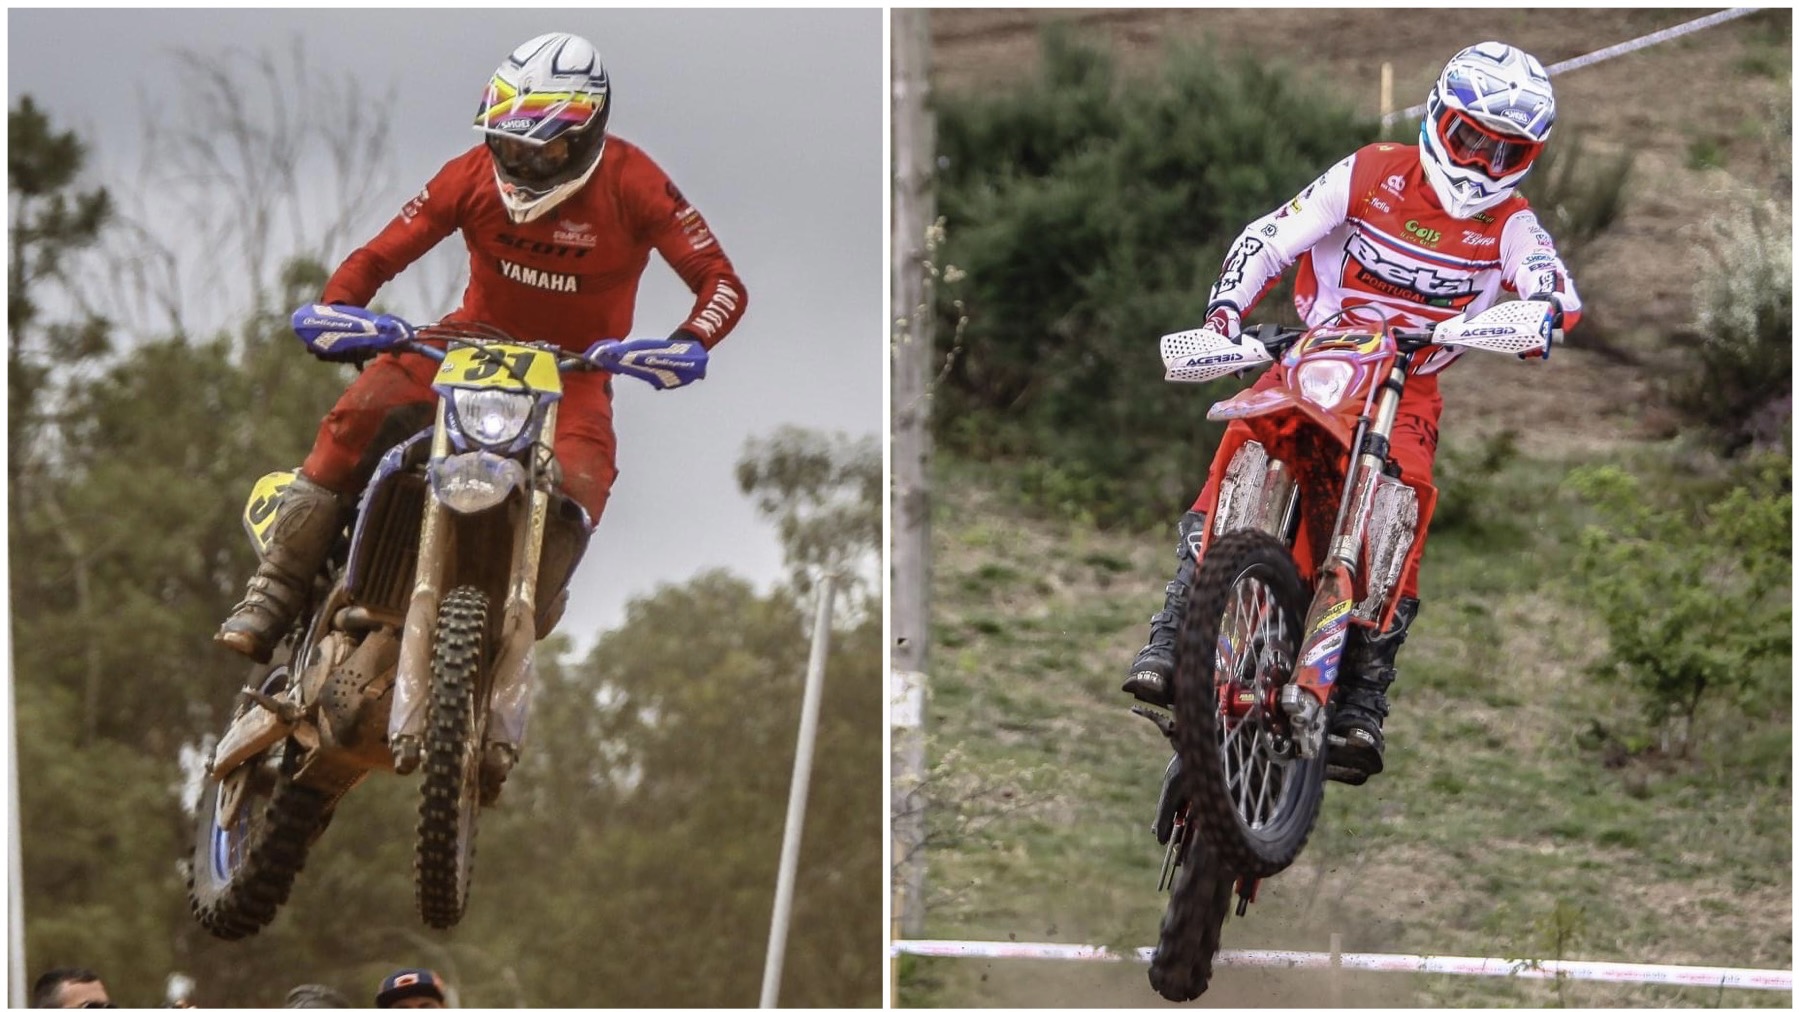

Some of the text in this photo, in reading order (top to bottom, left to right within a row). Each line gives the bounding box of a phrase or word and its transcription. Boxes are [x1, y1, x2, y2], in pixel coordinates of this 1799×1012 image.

[501, 119, 531, 130] SHOEI
[496, 232, 592, 259] SCOTT
[500, 259, 578, 292] YAMAHA
[1344, 232, 1480, 298] Beta
[1360, 272, 1429, 304] PORTUGAL
[1460, 326, 1517, 338] ACERBIS
[463, 348, 537, 381] 31
[1186, 352, 1244, 367] ACERBIS
